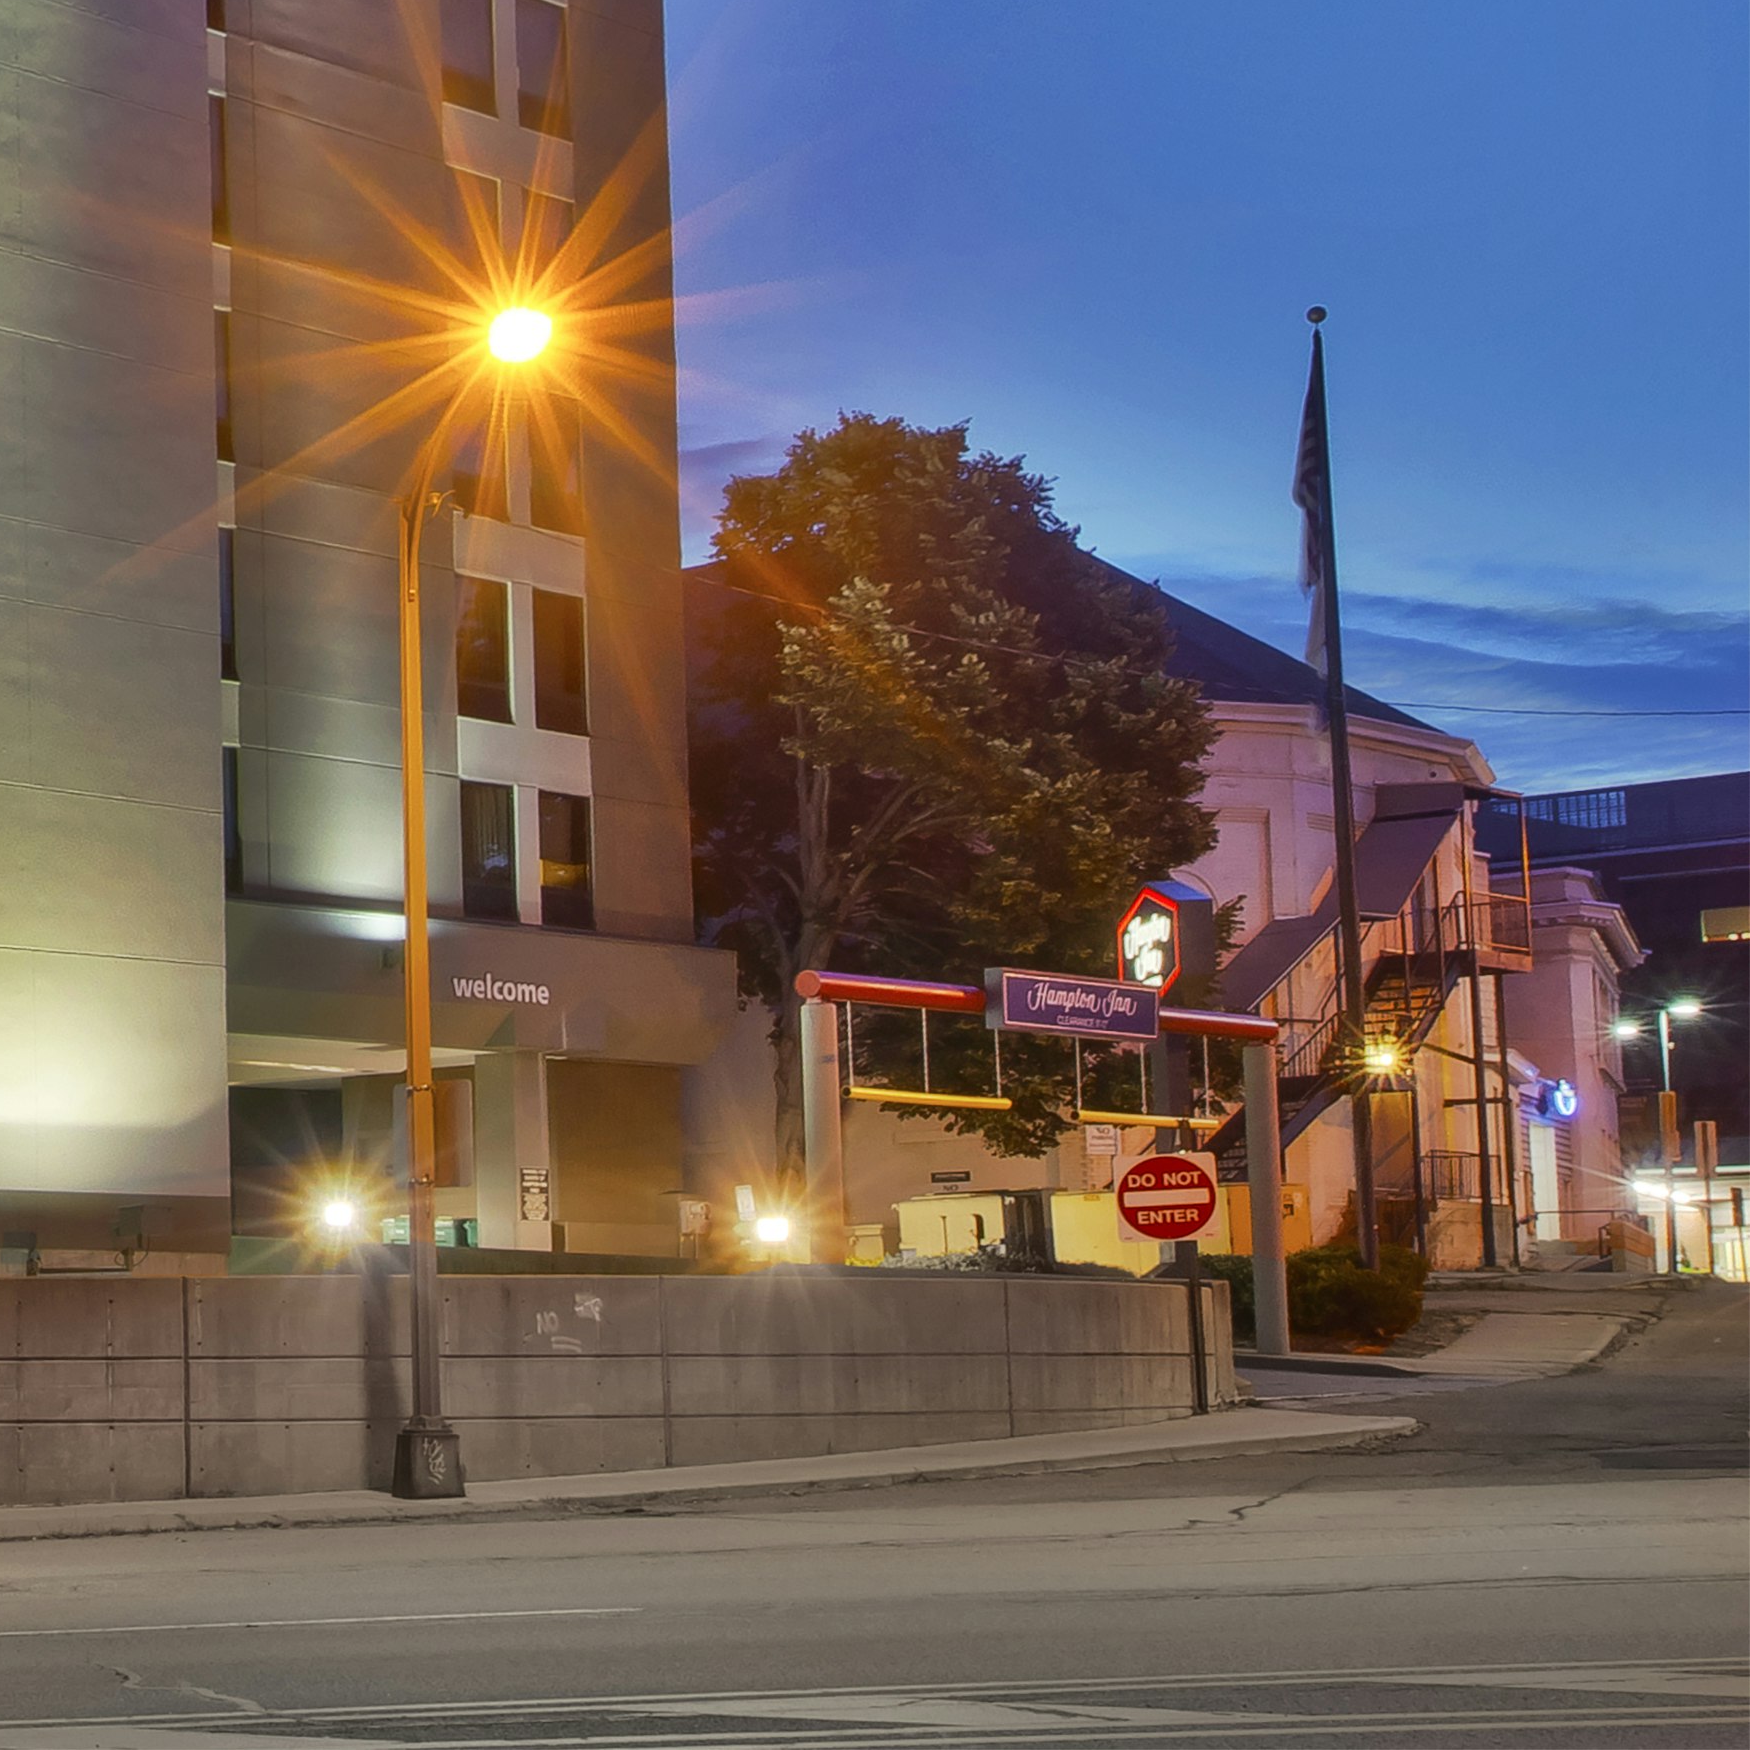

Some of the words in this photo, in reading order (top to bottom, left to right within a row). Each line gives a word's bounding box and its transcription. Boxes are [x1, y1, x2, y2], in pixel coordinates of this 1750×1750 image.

[452, 972, 550, 1005] welcome
[1027, 982, 1100, 1013] Hampton
[1101, 989, 1137, 1017] Inn
[1127, 1173, 1156, 1188] DO
[1162, 1171, 1202, 1186] NOT
[1137, 1208, 1200, 1225] ENTER
